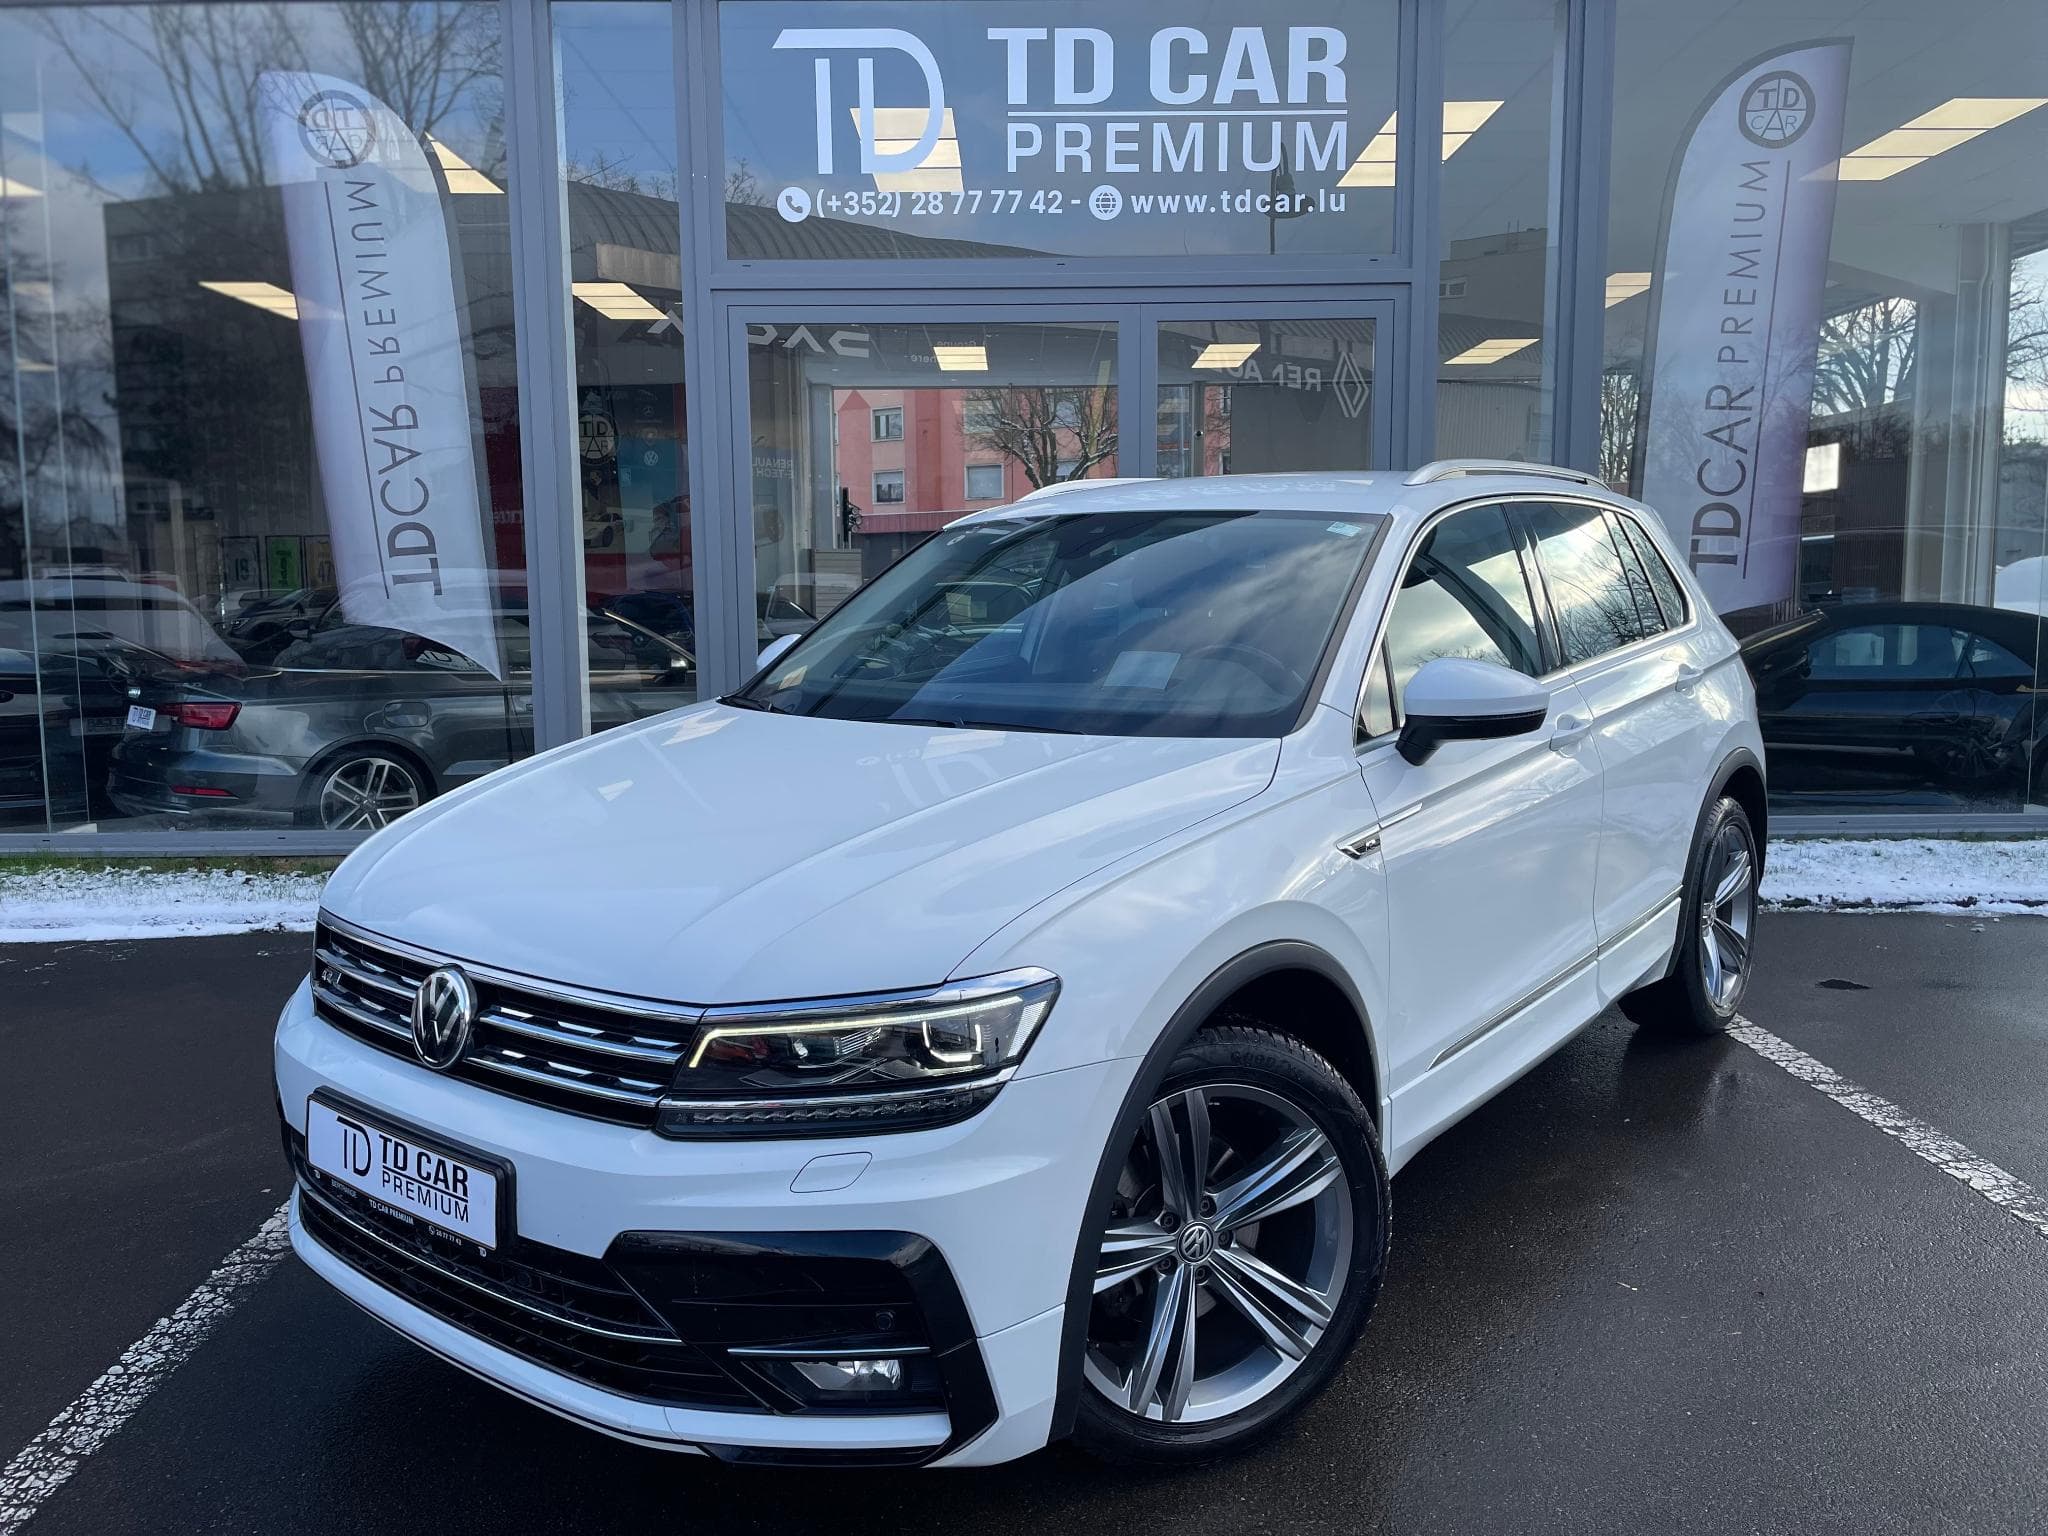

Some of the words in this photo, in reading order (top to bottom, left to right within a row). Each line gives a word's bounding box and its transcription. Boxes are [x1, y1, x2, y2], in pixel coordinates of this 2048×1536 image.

[987, 26, 1114, 105] TD
[1149, 26, 1348, 105] CAR
[1757, 87, 1800, 108] TD
[1007, 121, 1348, 174] PREMIUM
[815, 188, 901, 218] (+352)
[911, 190, 944, 216] 28
[952, 190, 981, 215] 77
[990, 190, 1023, 215] 77
[1030, 190, 1064, 215] 42
[1130, 188, 1347, 214] www.tdcar.lu
[1717, 160, 1771, 364] PREMIUM
[379, 1133, 408, 1172] TD
[416, 1151, 469, 1197] CAR
[382, 1170, 469, 1223] PREMIUM
